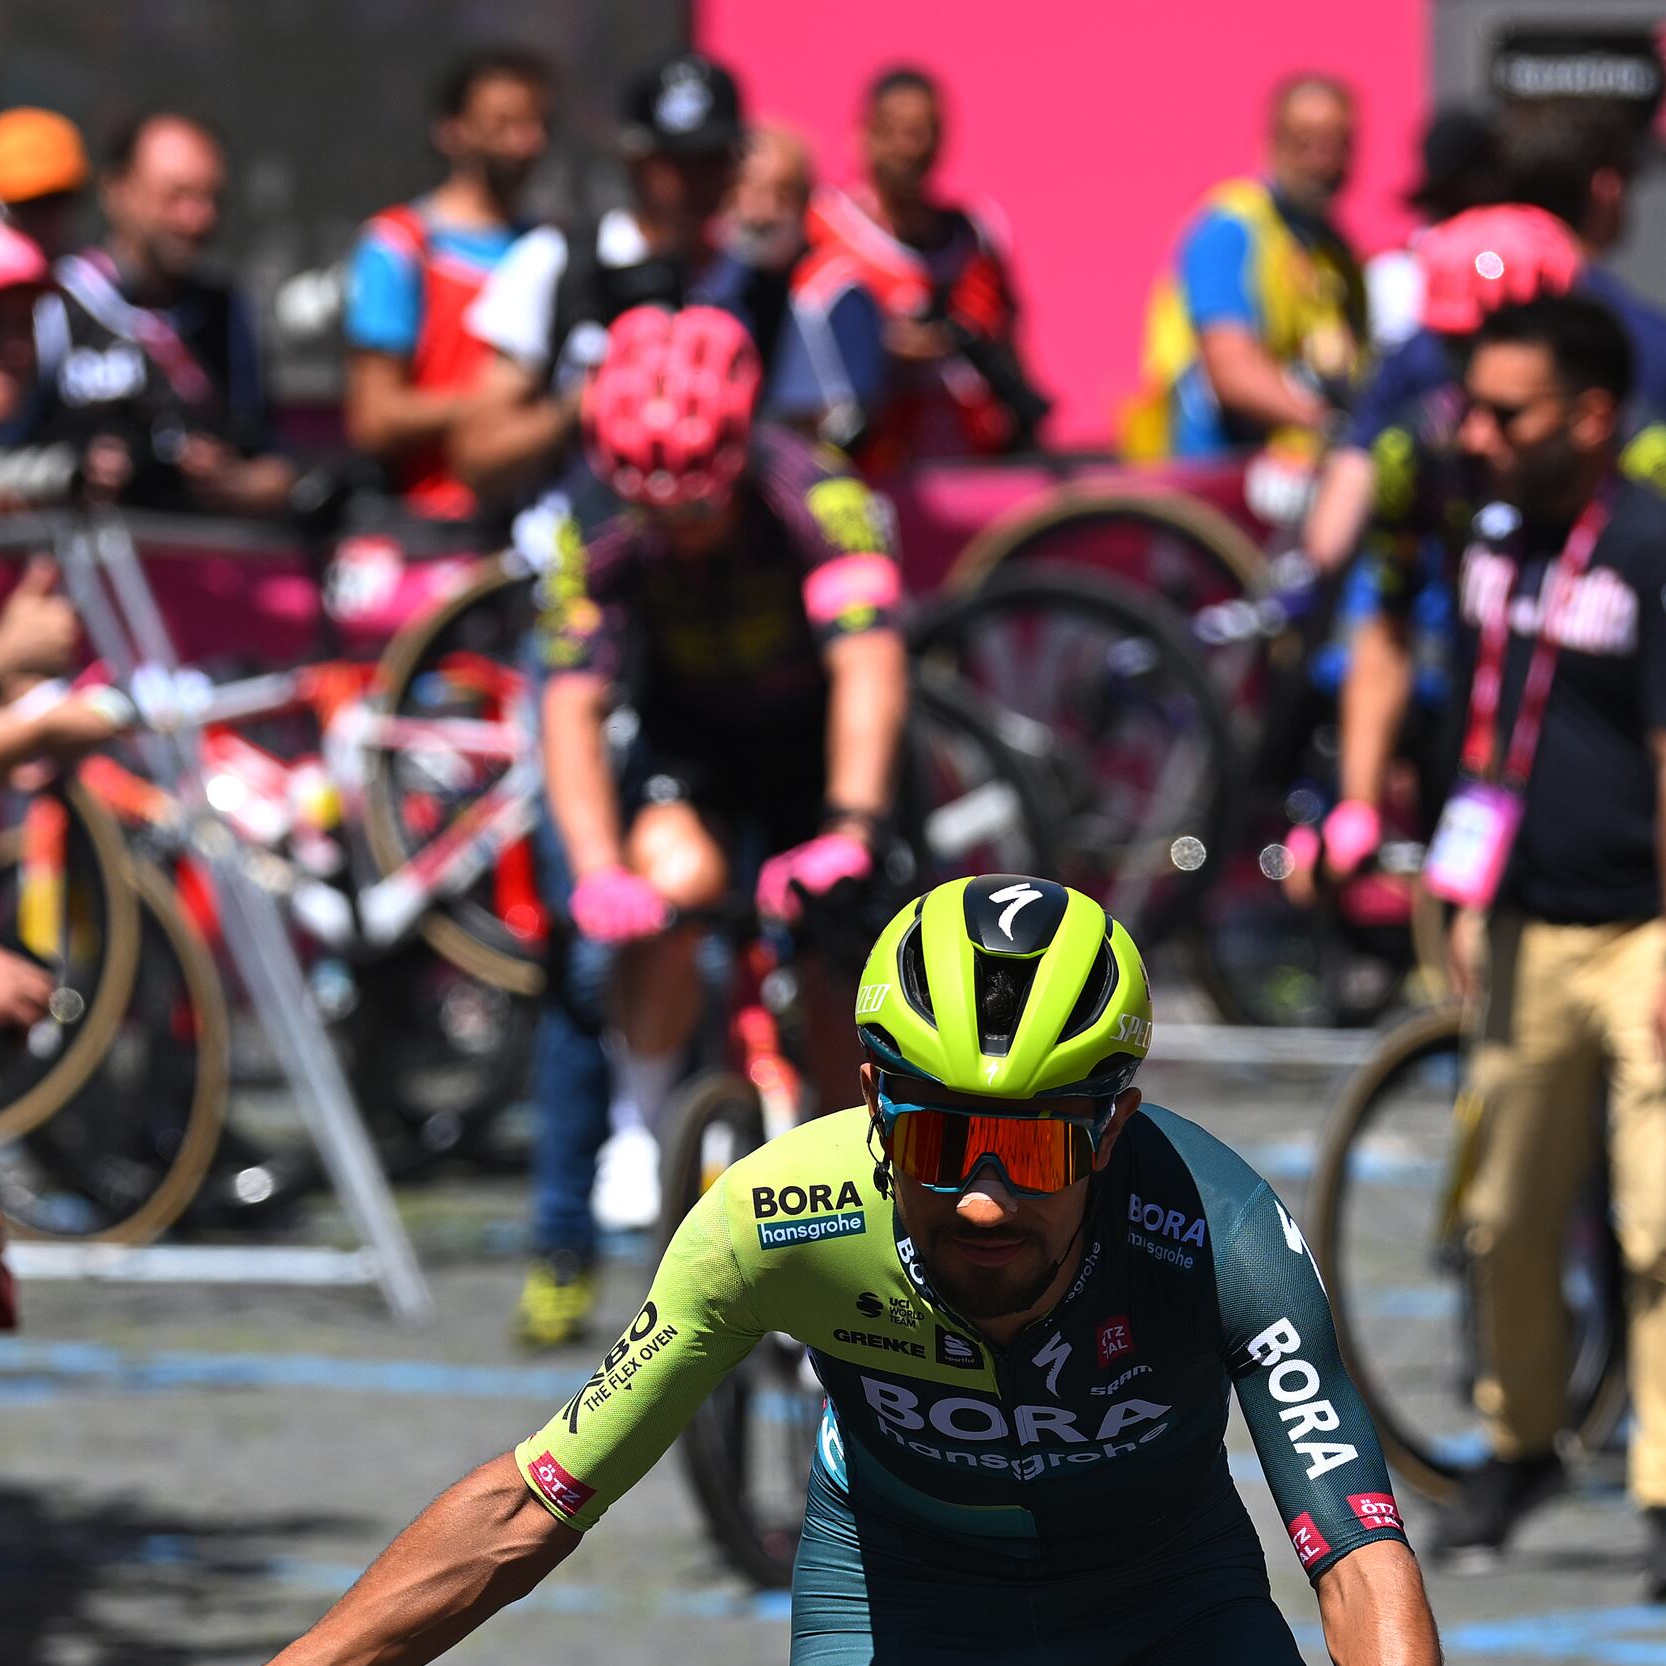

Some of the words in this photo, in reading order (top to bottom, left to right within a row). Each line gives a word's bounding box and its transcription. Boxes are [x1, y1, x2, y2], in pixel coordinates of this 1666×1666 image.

[752, 1181, 863, 1219] BORA
[761, 1214, 862, 1243] hansgrohe
[1127, 1193, 1206, 1248] BORA
[889, 1297, 909, 1309] UCI
[889, 1306, 925, 1321] WORLD
[889, 1315, 916, 1328] TEAM
[833, 1328, 926, 1359] GRENKE
[583, 1385, 612, 1412] THE
[607, 1357, 642, 1391] FLEX
[639, 1324, 679, 1361] OVEN
[860, 1375, 1173, 1446] BORA
[1247, 1316, 1359, 1481] BORA
[878, 1415, 1169, 1481] hansgrohe
